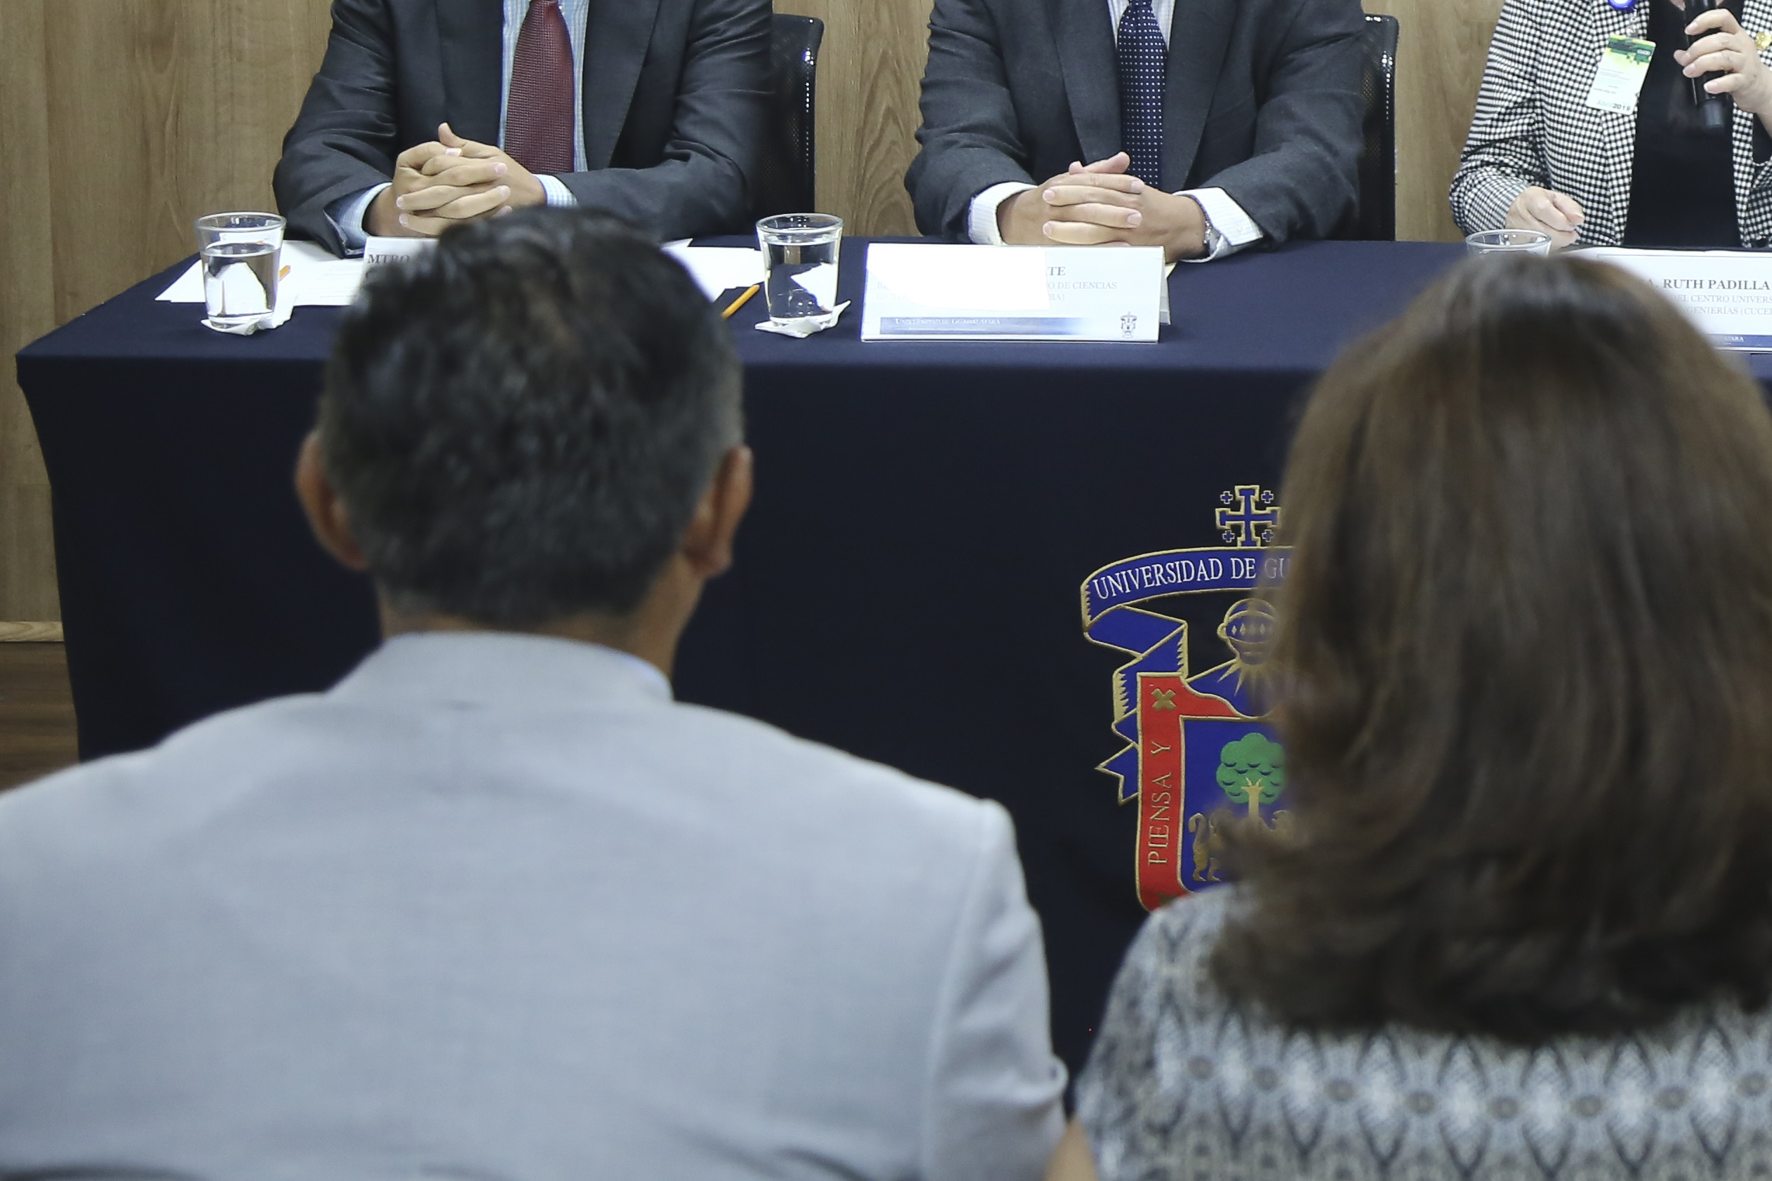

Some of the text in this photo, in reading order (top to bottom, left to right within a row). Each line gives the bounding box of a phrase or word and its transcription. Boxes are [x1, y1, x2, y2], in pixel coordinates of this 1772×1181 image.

[1057, 281, 1071, 290] DE
[1072, 281, 1118, 290] CIENCIAS
[1662, 279, 1704, 290] RUTH
[1708, 279, 1770, 291] PADILLA
[1691, 294, 1730, 304] CENTRO
[1683, 306, 1739, 316] GENIERÍAS
[1092, 557, 1223, 600] UNIVERSIDAD
[1230, 557, 1257, 580] DE
[1147, 740, 1172, 866] PIENSA Y
